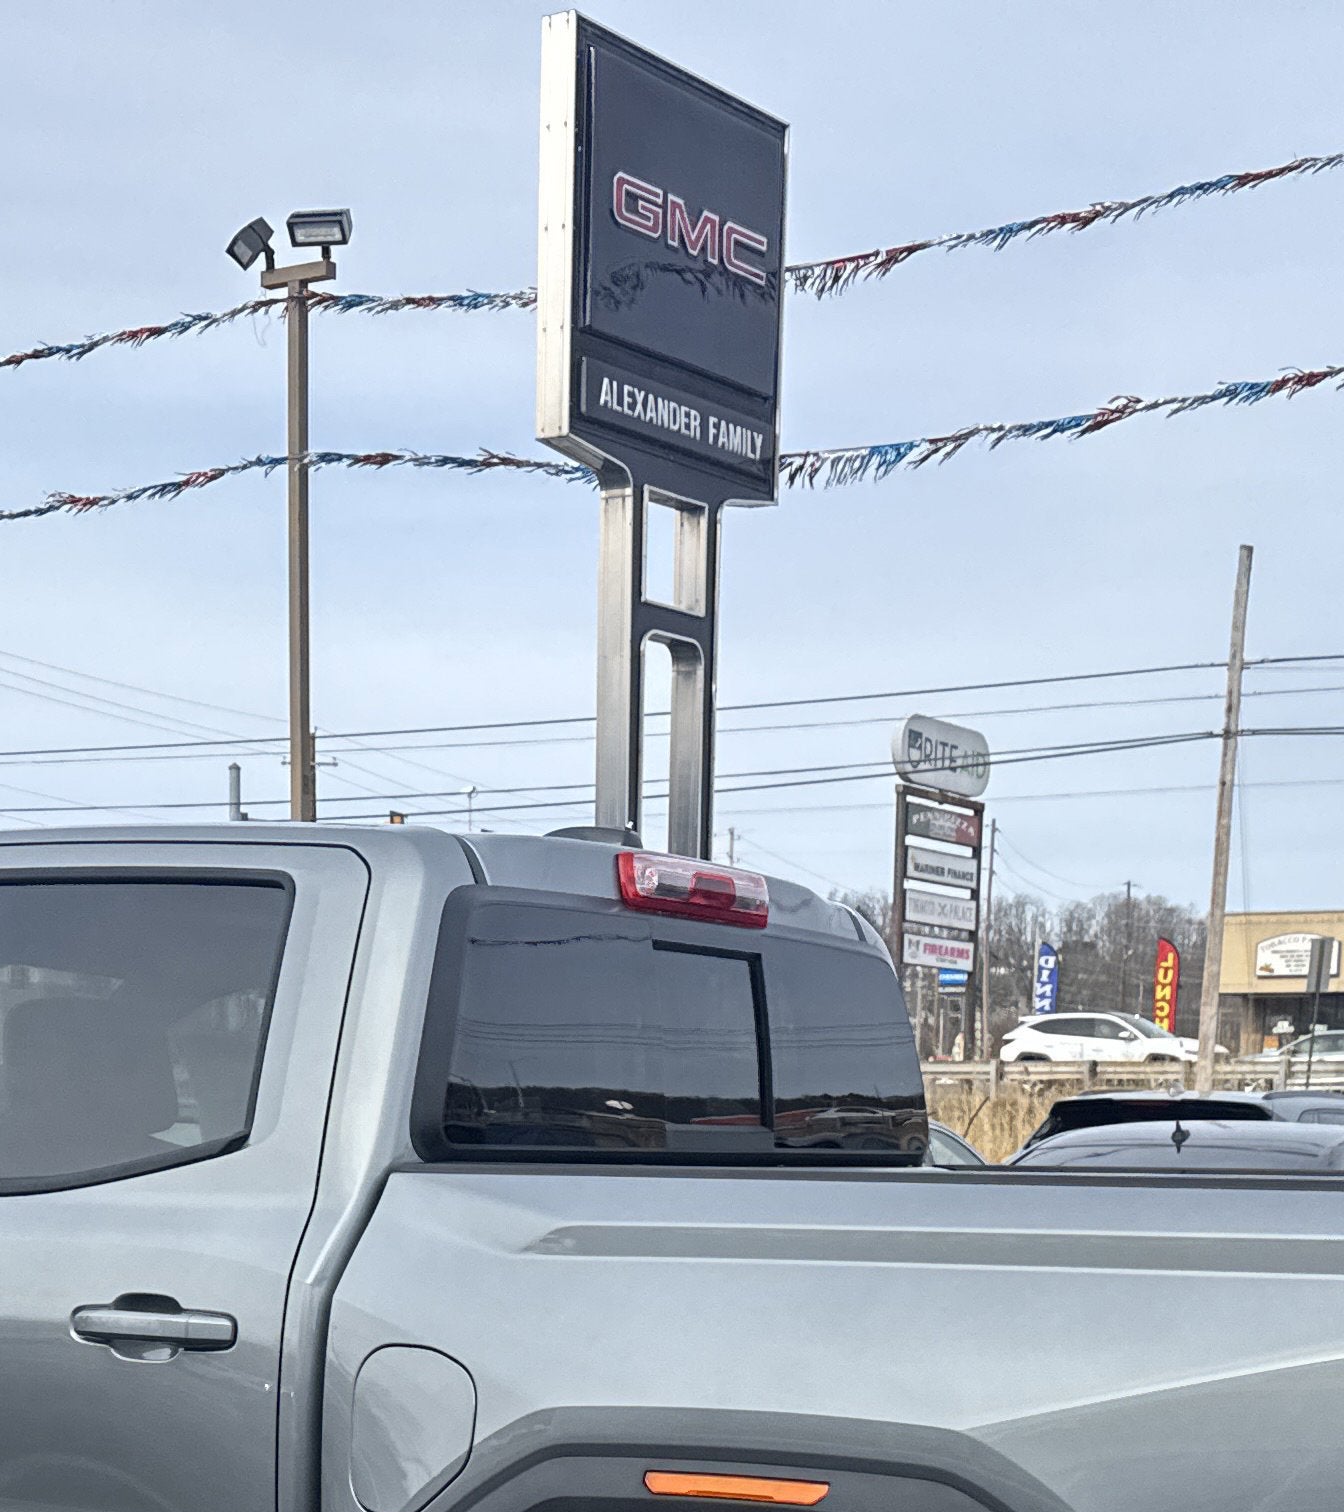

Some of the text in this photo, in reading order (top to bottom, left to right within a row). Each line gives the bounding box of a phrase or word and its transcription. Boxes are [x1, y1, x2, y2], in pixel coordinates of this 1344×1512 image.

[612, 171, 768, 286] GMC
[599, 376, 764, 462] ALEXANDER FAMILY
[924, 736, 958, 773] RITE
[923, 942, 971, 960] FIREARMS
